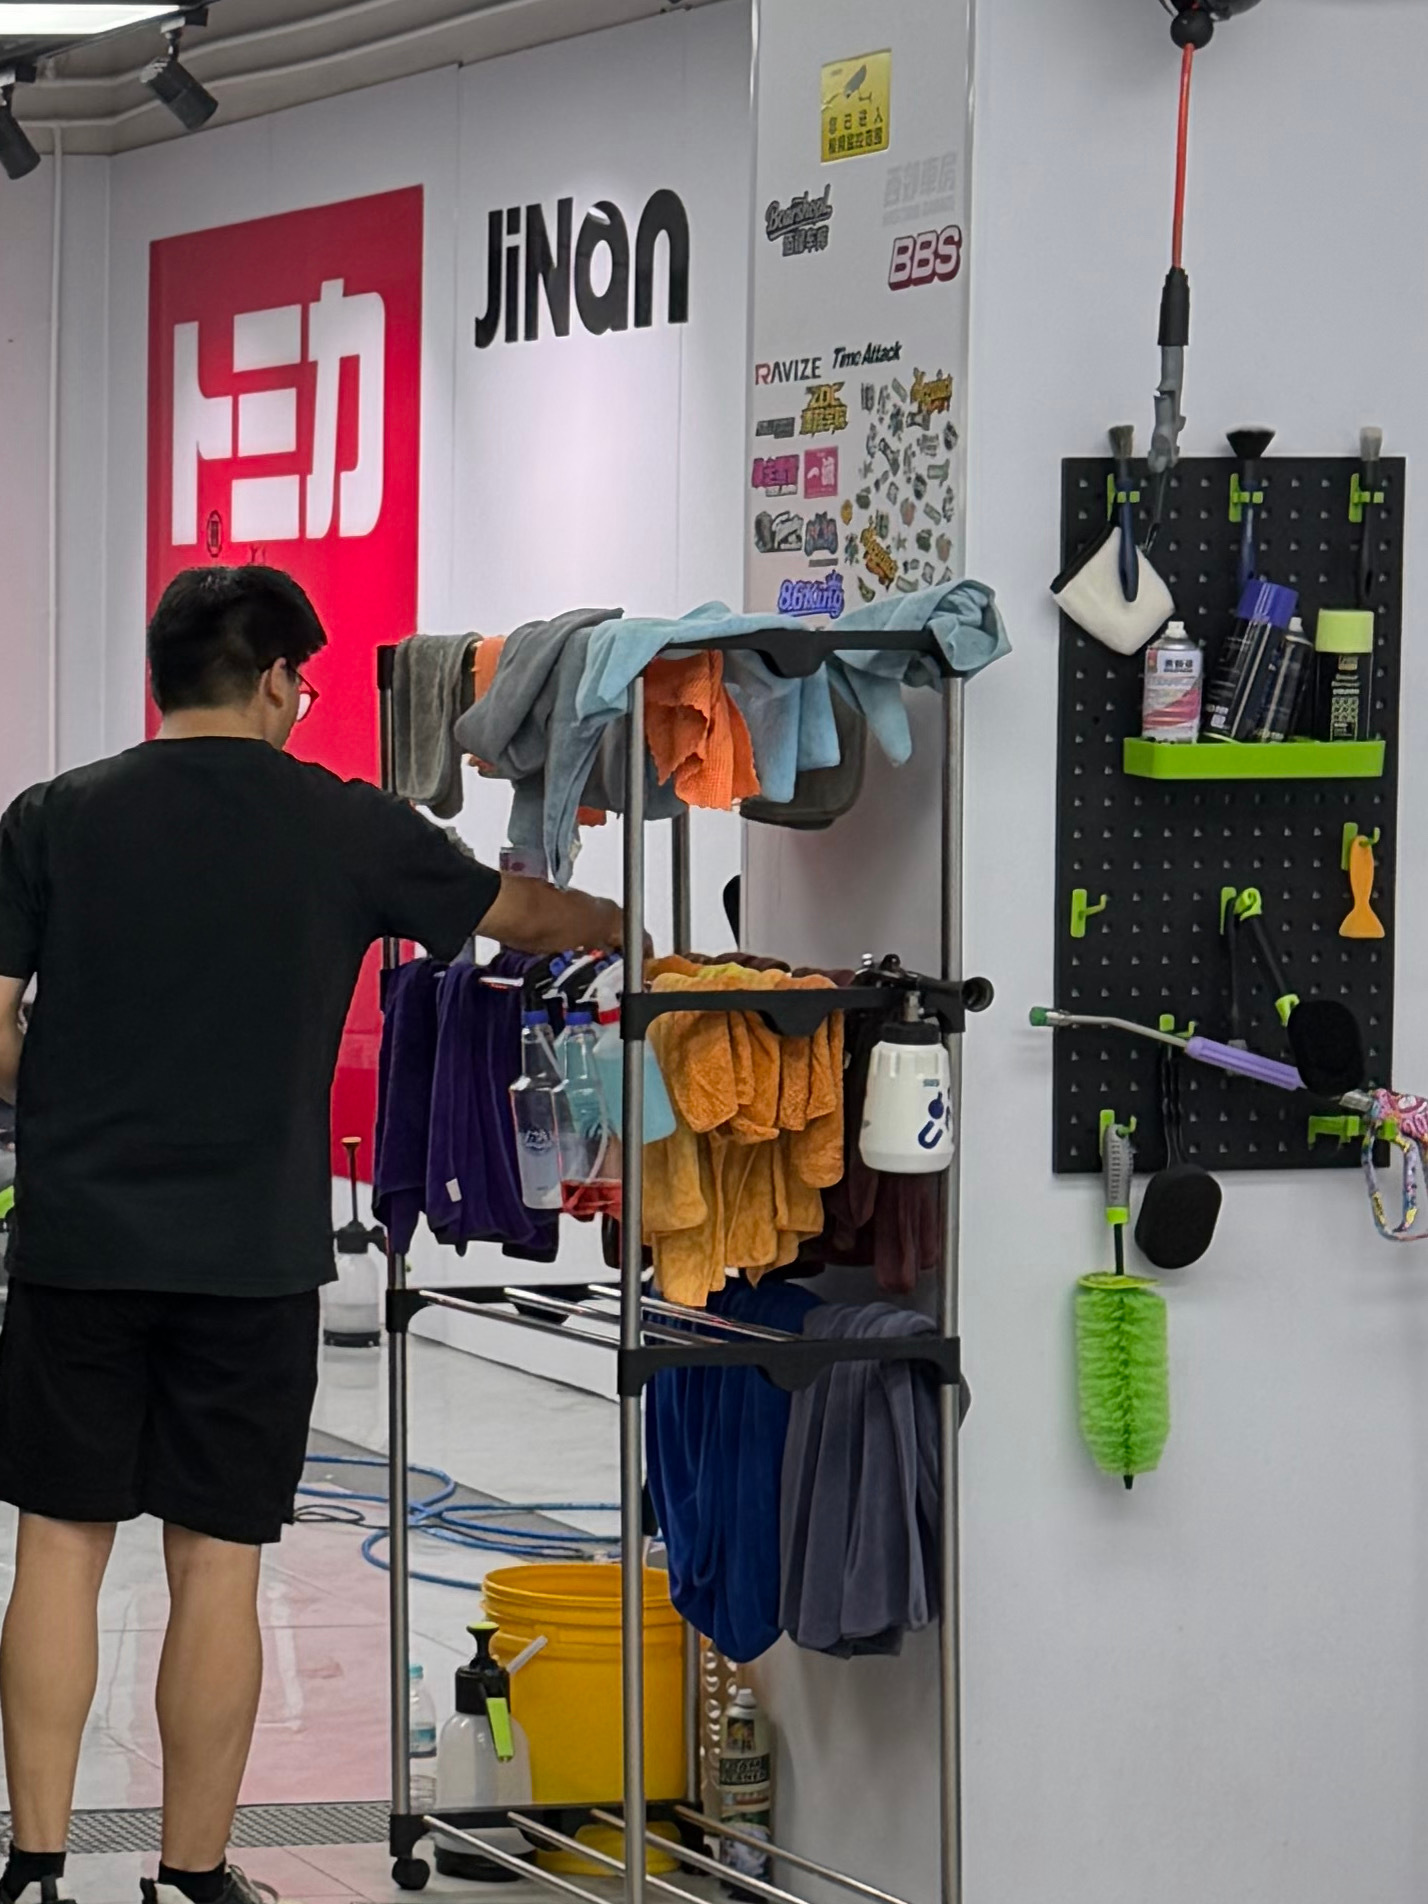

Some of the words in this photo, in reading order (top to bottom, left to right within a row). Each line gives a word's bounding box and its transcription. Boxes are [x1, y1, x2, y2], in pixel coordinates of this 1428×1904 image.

[887, 224, 963, 292] BBS
[754, 355, 823, 386] RAVIZE
[832, 346, 861, 369] Time
[861, 340, 903, 366] Attack
